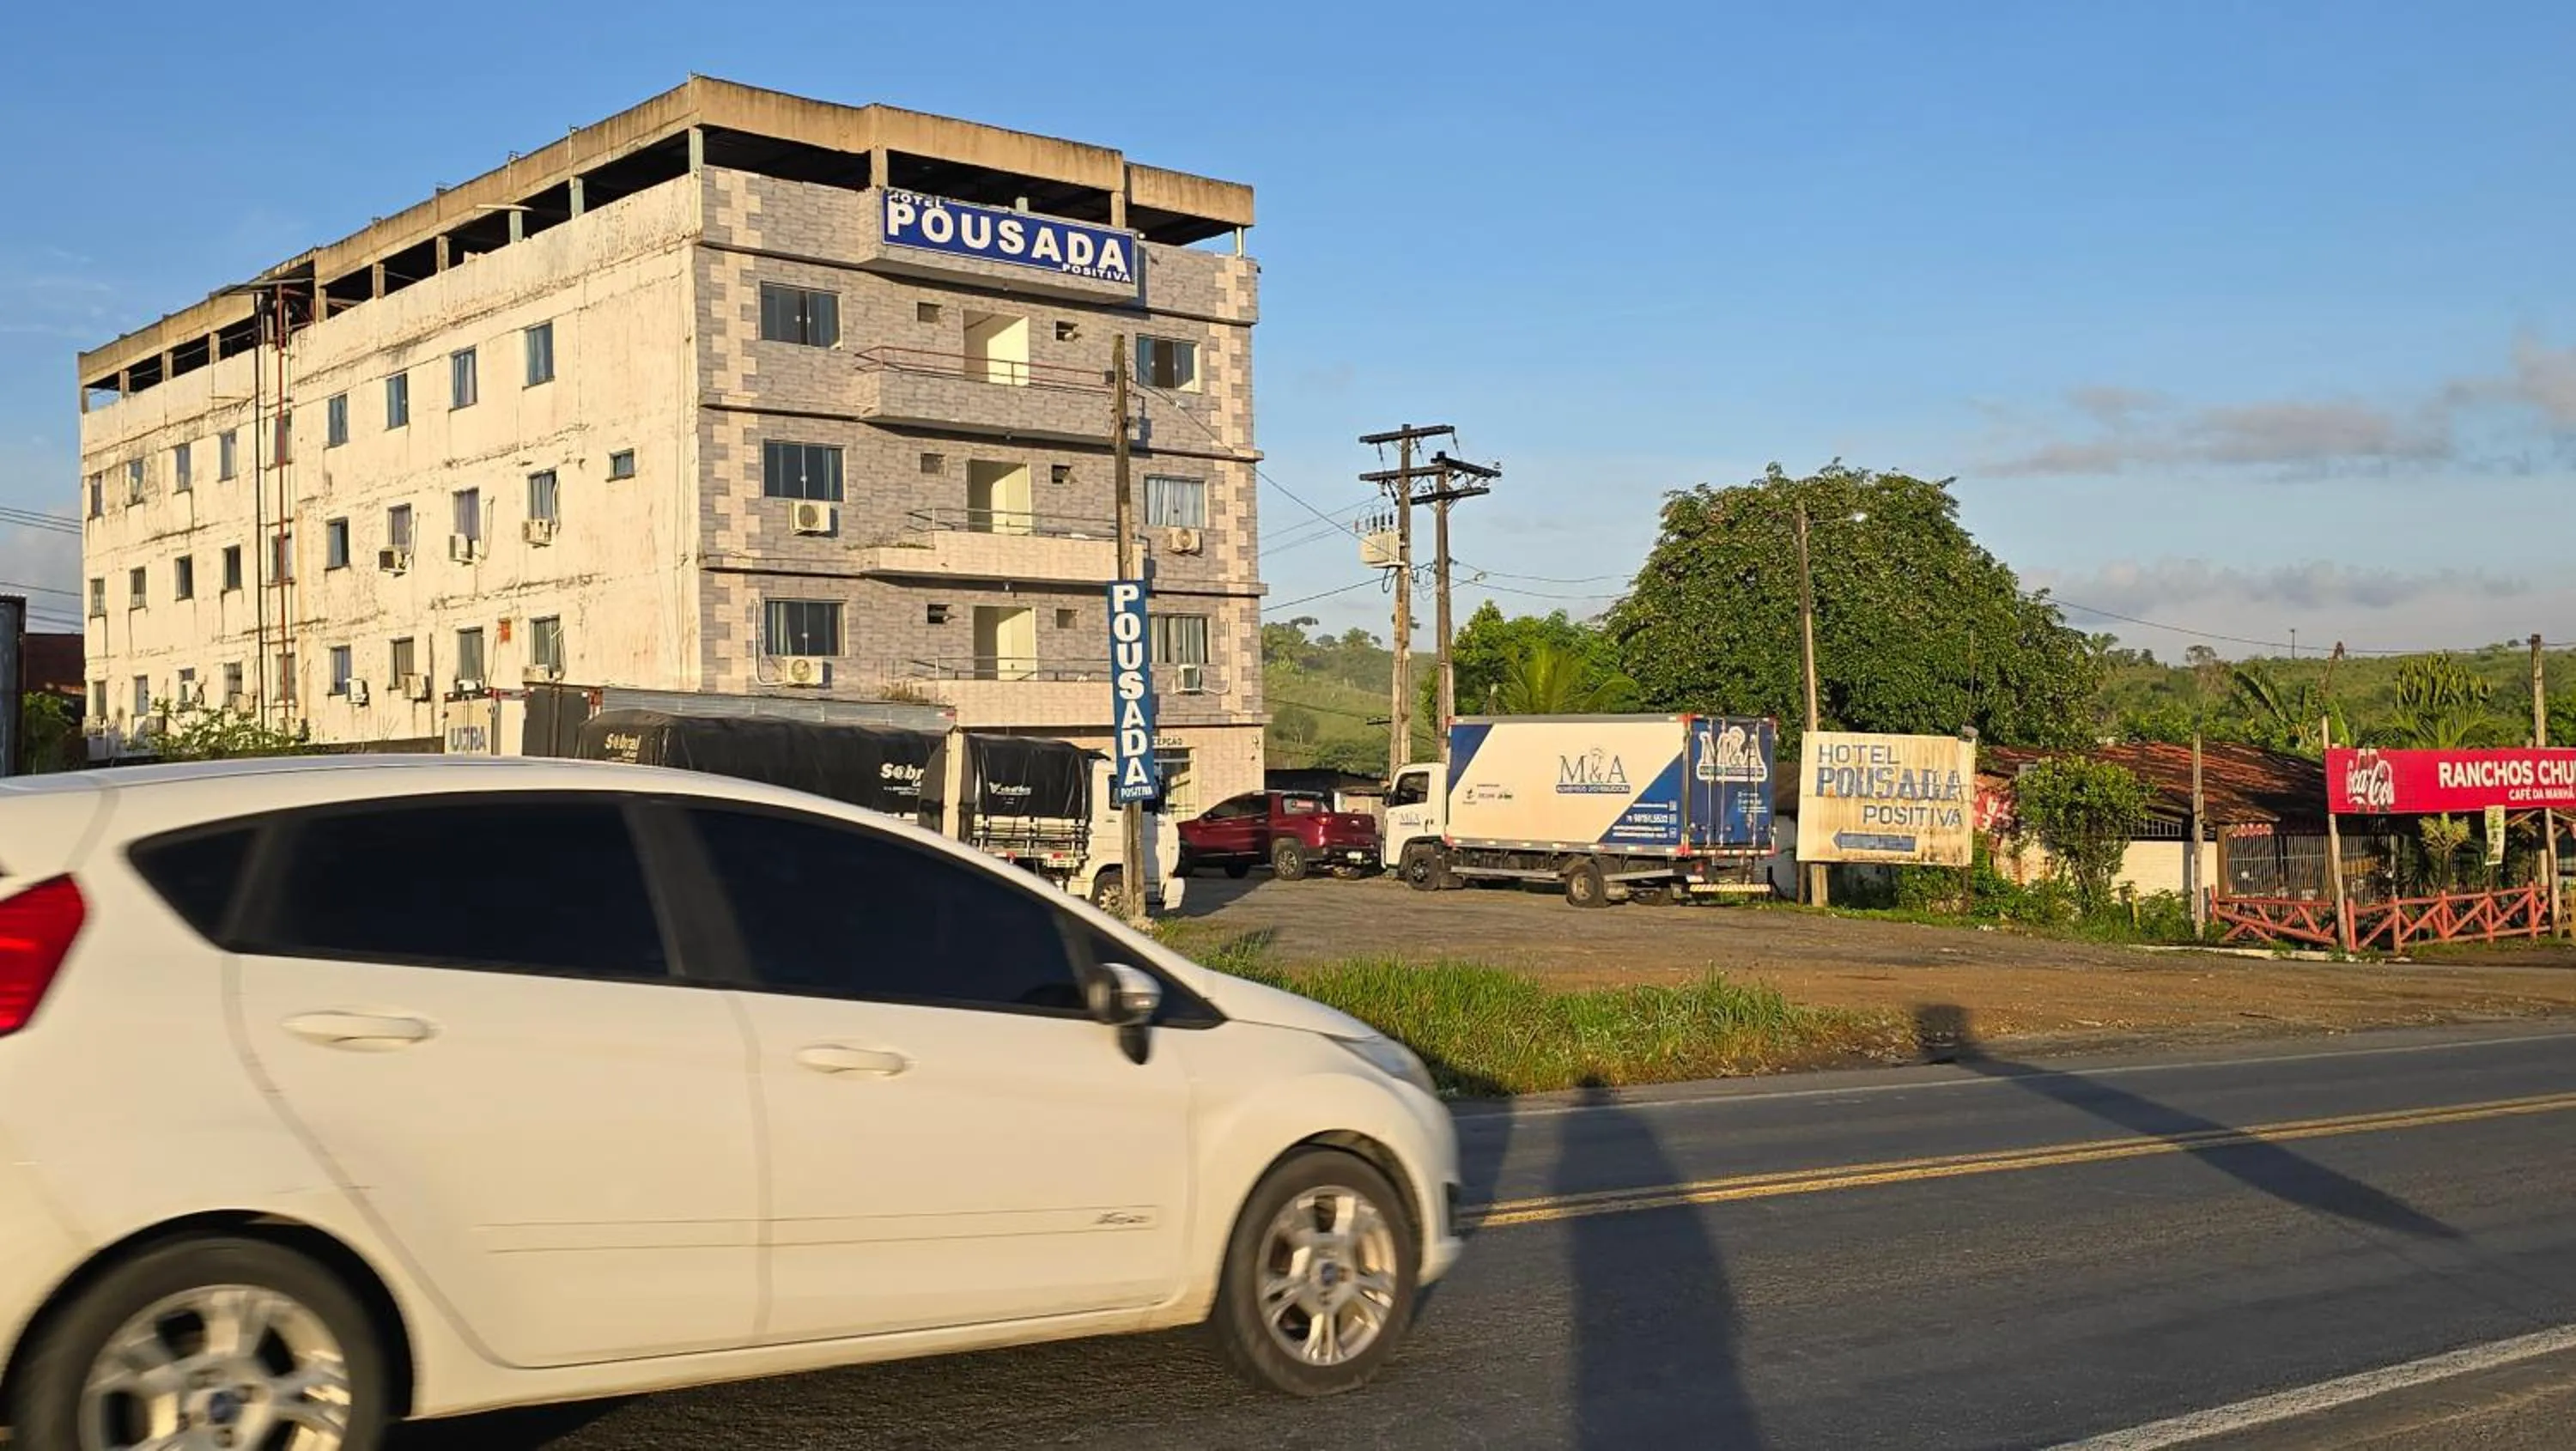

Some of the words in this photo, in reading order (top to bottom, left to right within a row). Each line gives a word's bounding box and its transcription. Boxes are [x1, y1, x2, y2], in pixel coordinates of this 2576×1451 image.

[888, 203, 1127, 273] POUSADA
[1062, 263, 1132, 282] POSITIVA
[1112, 584, 1149, 786] POUSADA
[1559, 748, 1627, 783] M&A
[1818, 744, 1900, 764] HOTEL
[1816, 767, 1963, 800] POUSADA
[2439, 760, 2534, 789] RANCHOS
[2538, 759, 2576, 786] CHU
[2508, 786, 2532, 800] CAFÉ
[2533, 787, 2544, 799] DA
[1862, 804, 1963, 827] POSITIVA
